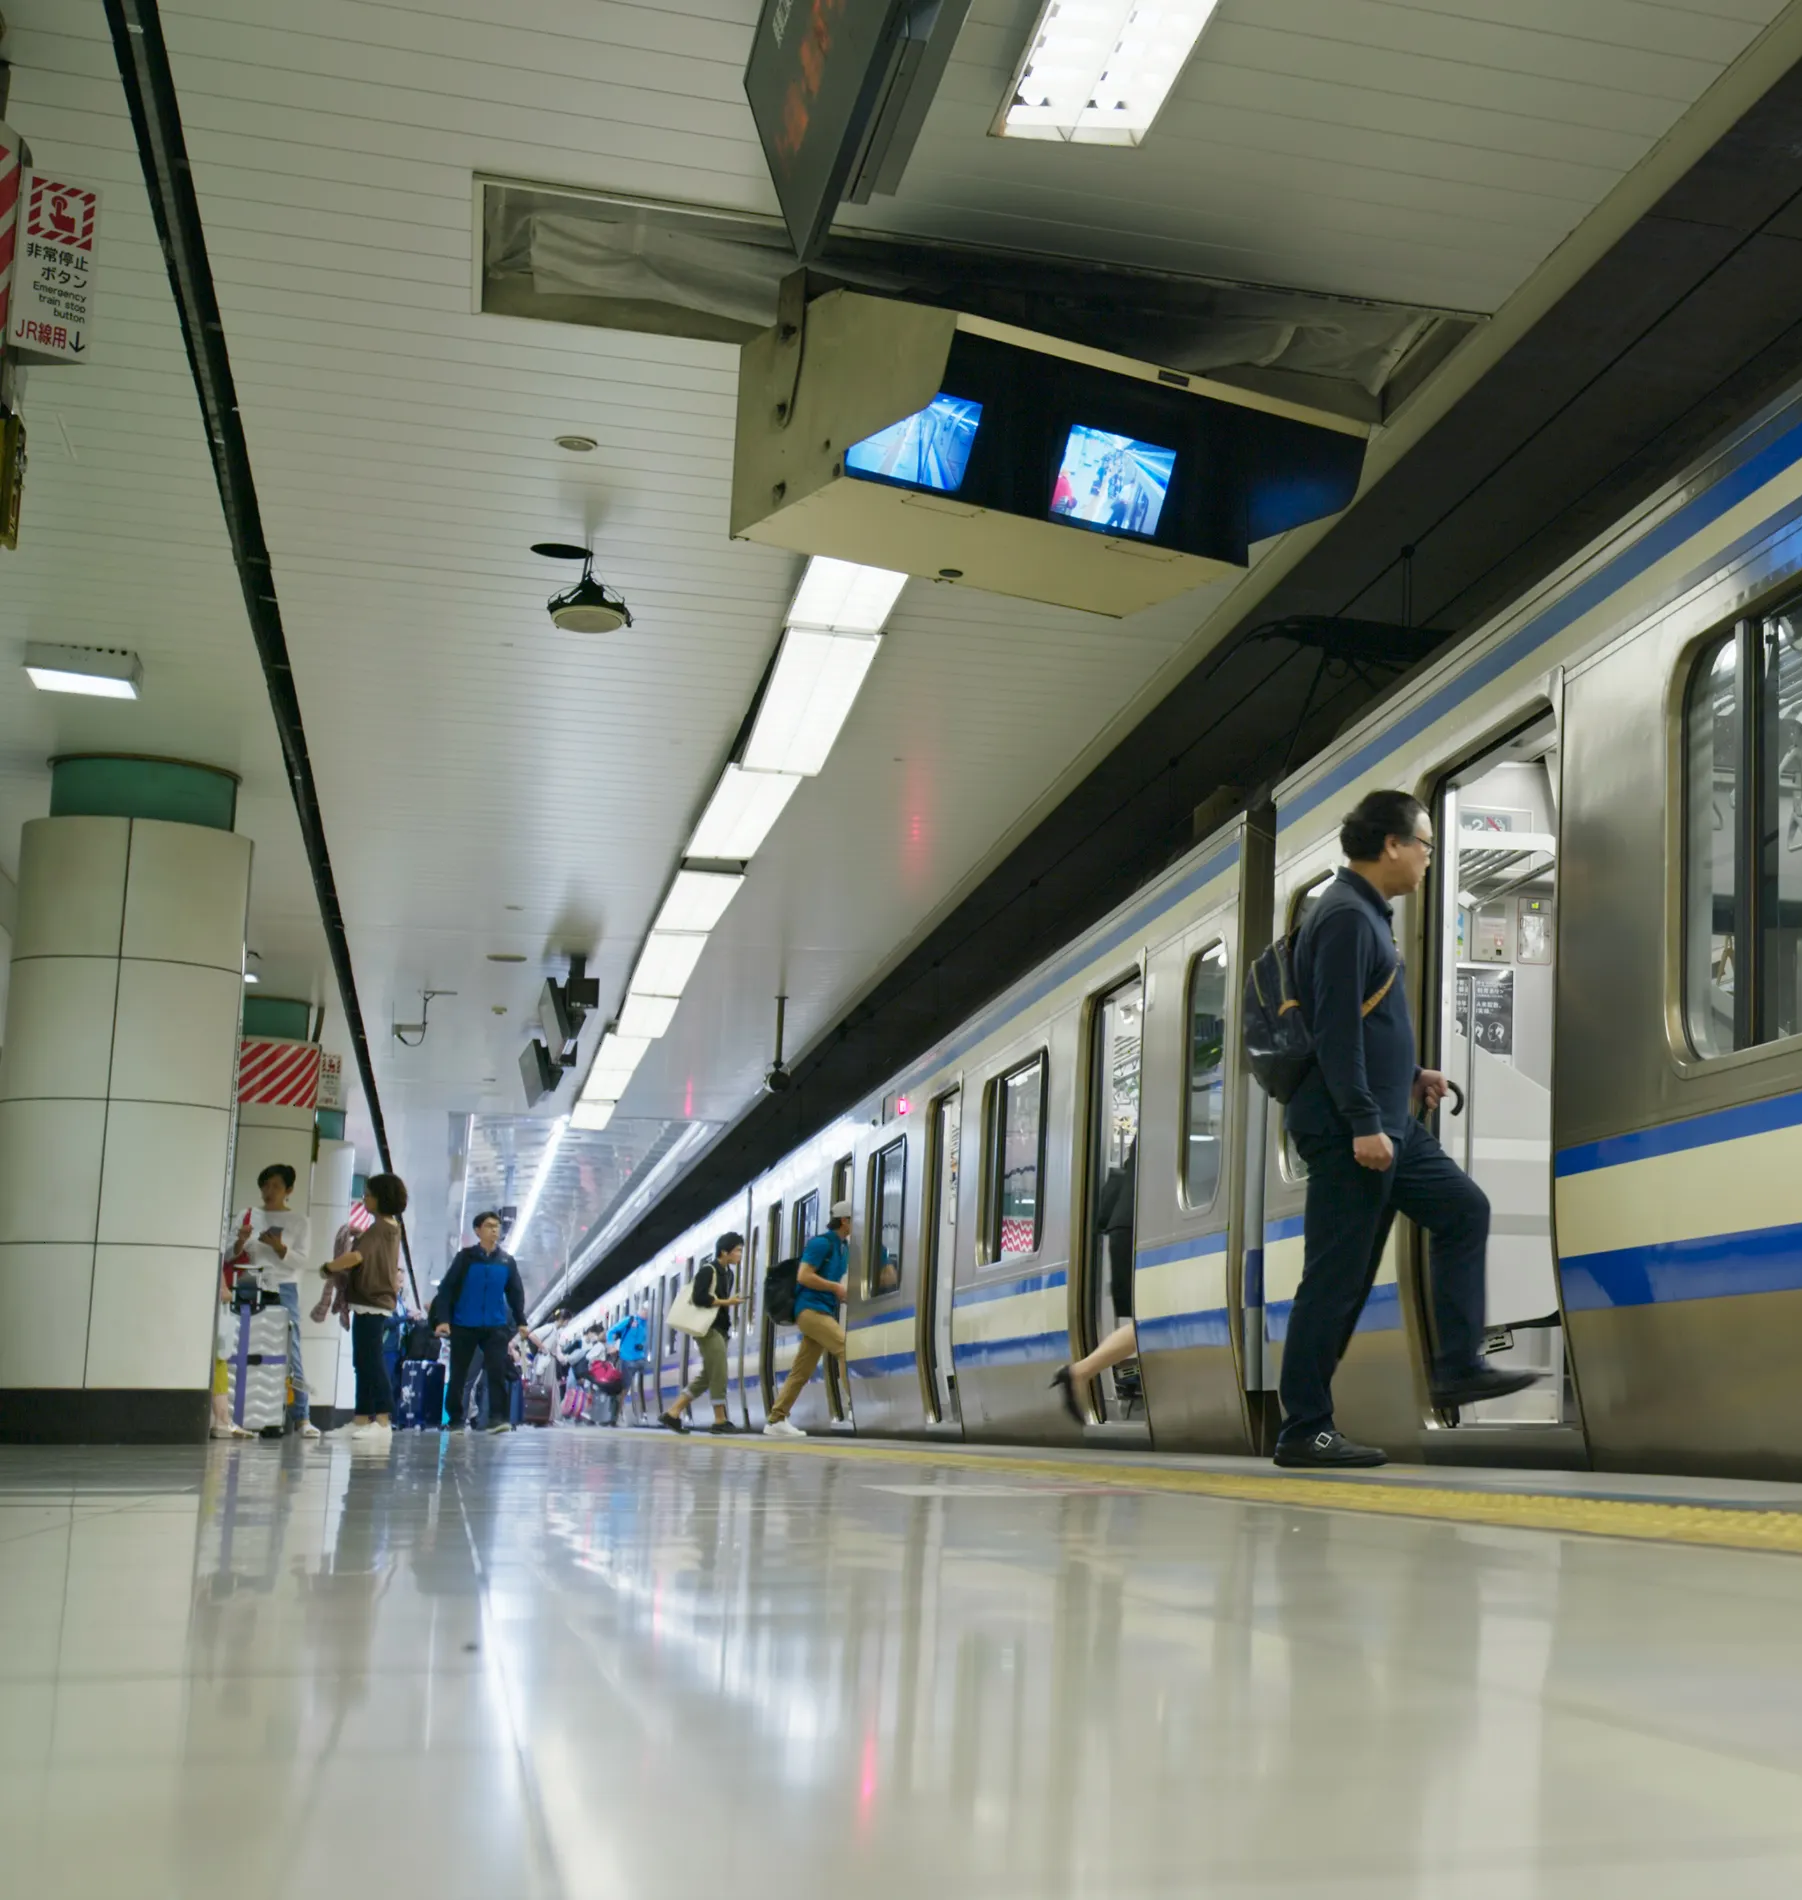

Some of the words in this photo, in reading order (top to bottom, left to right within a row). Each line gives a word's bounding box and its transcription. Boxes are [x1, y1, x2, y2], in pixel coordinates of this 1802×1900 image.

[26, 242, 89, 272] 非常停止
[41, 266, 87, 289] ボタン
[33, 281, 87, 303] Emergency
[39, 294, 61, 307] train
[65, 302, 86, 314] stop
[53, 308, 85, 324] button
[15, 319, 67, 350] JR線用
